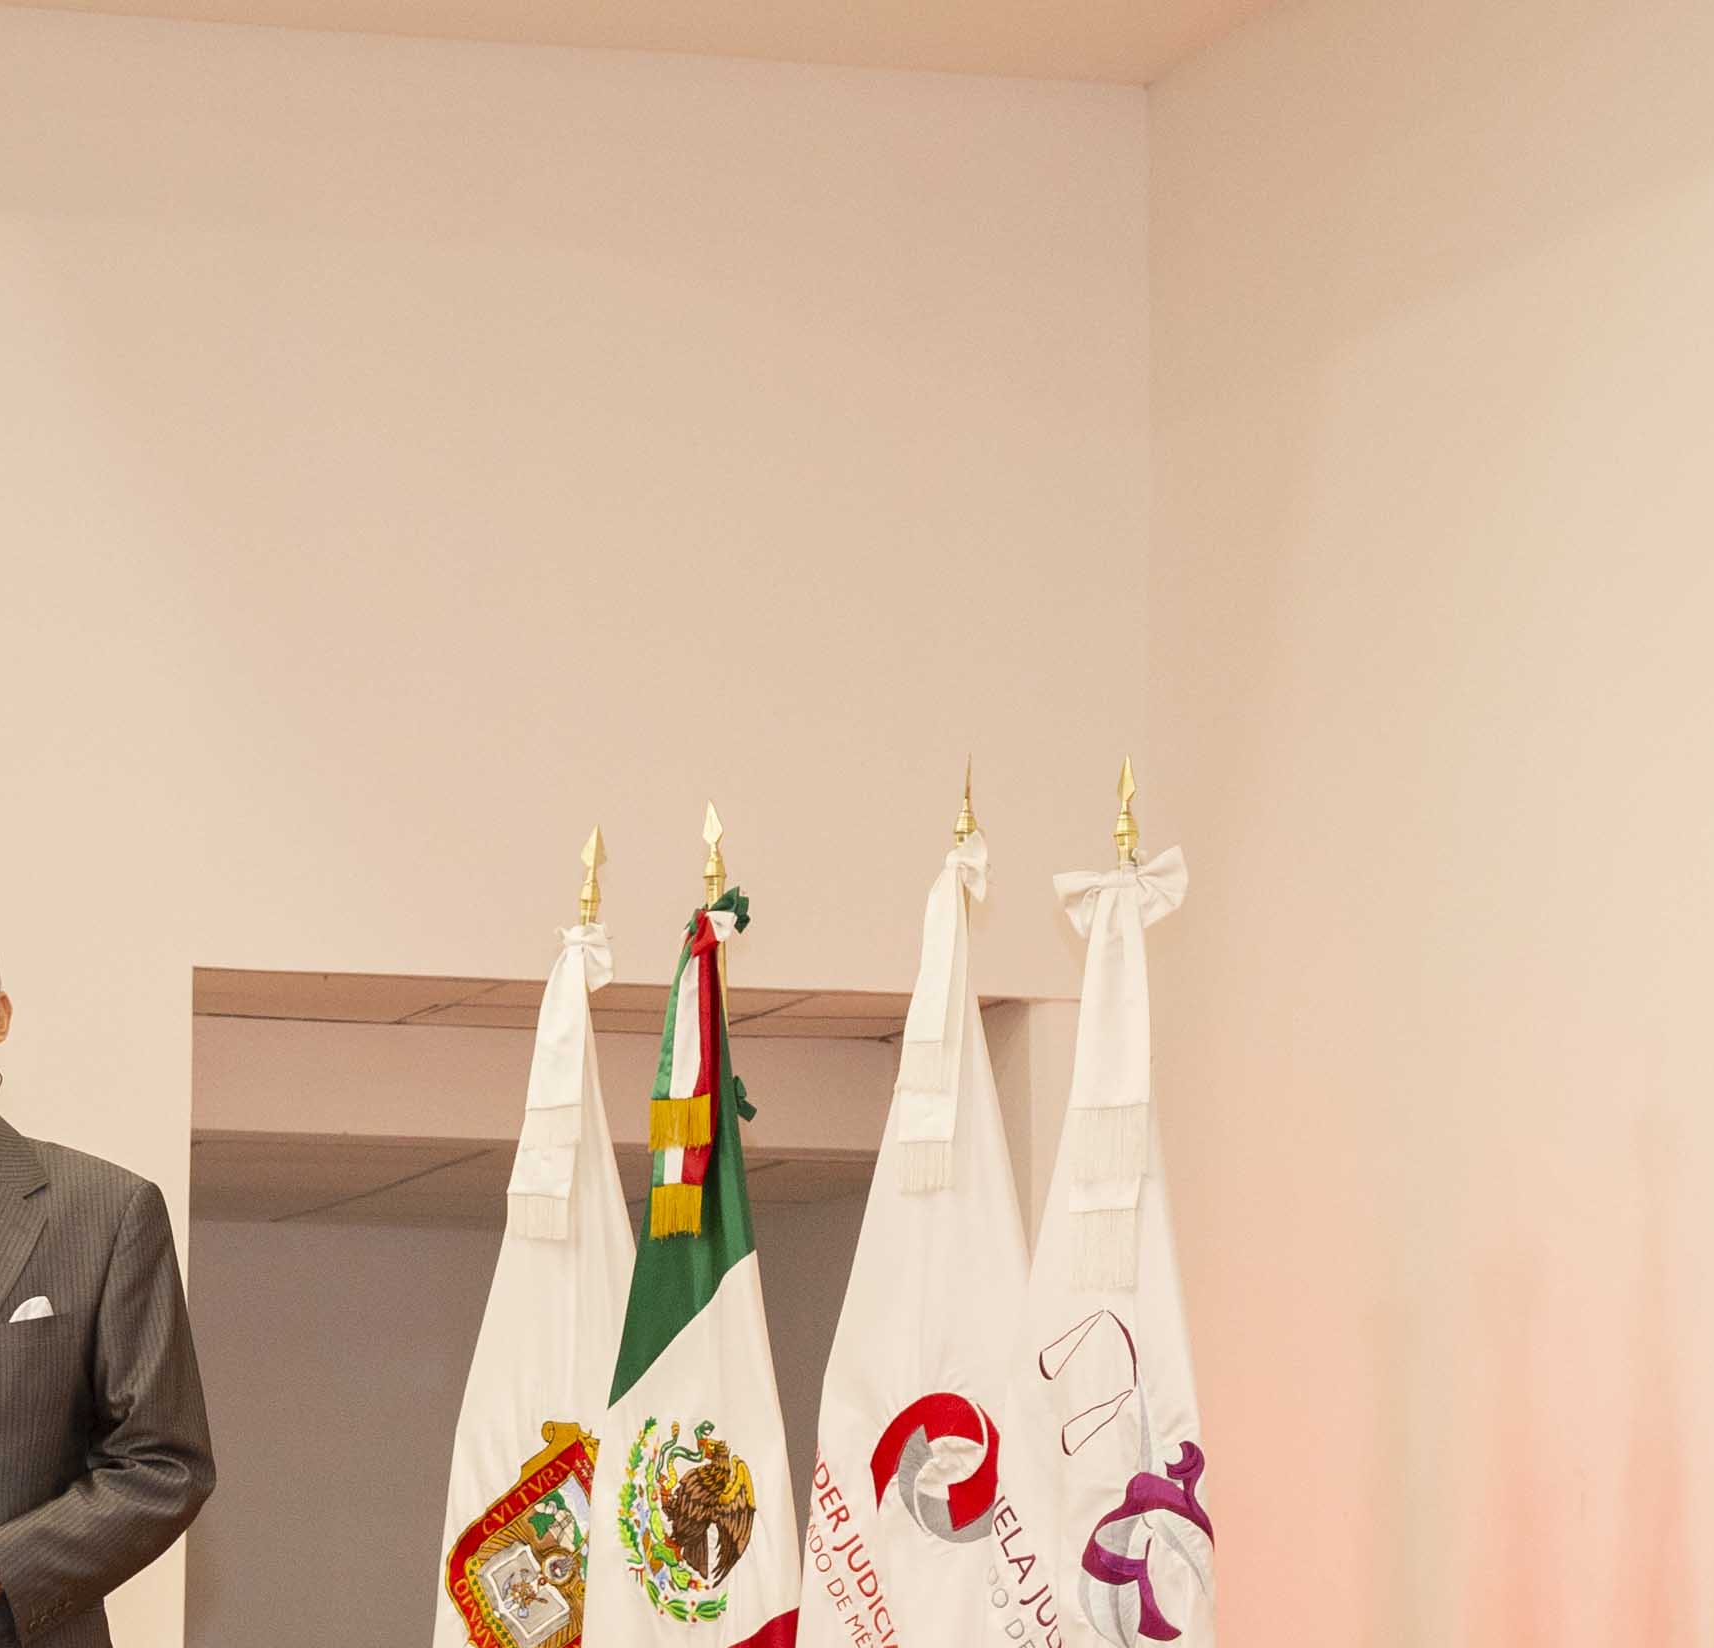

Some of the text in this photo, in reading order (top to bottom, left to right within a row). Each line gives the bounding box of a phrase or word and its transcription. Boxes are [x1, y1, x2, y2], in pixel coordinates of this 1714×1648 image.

[482, 1460, 571, 1536] CVLTVRA
[813, 1455, 851, 1534] DER
[826, 1577, 854, 1613] DE
